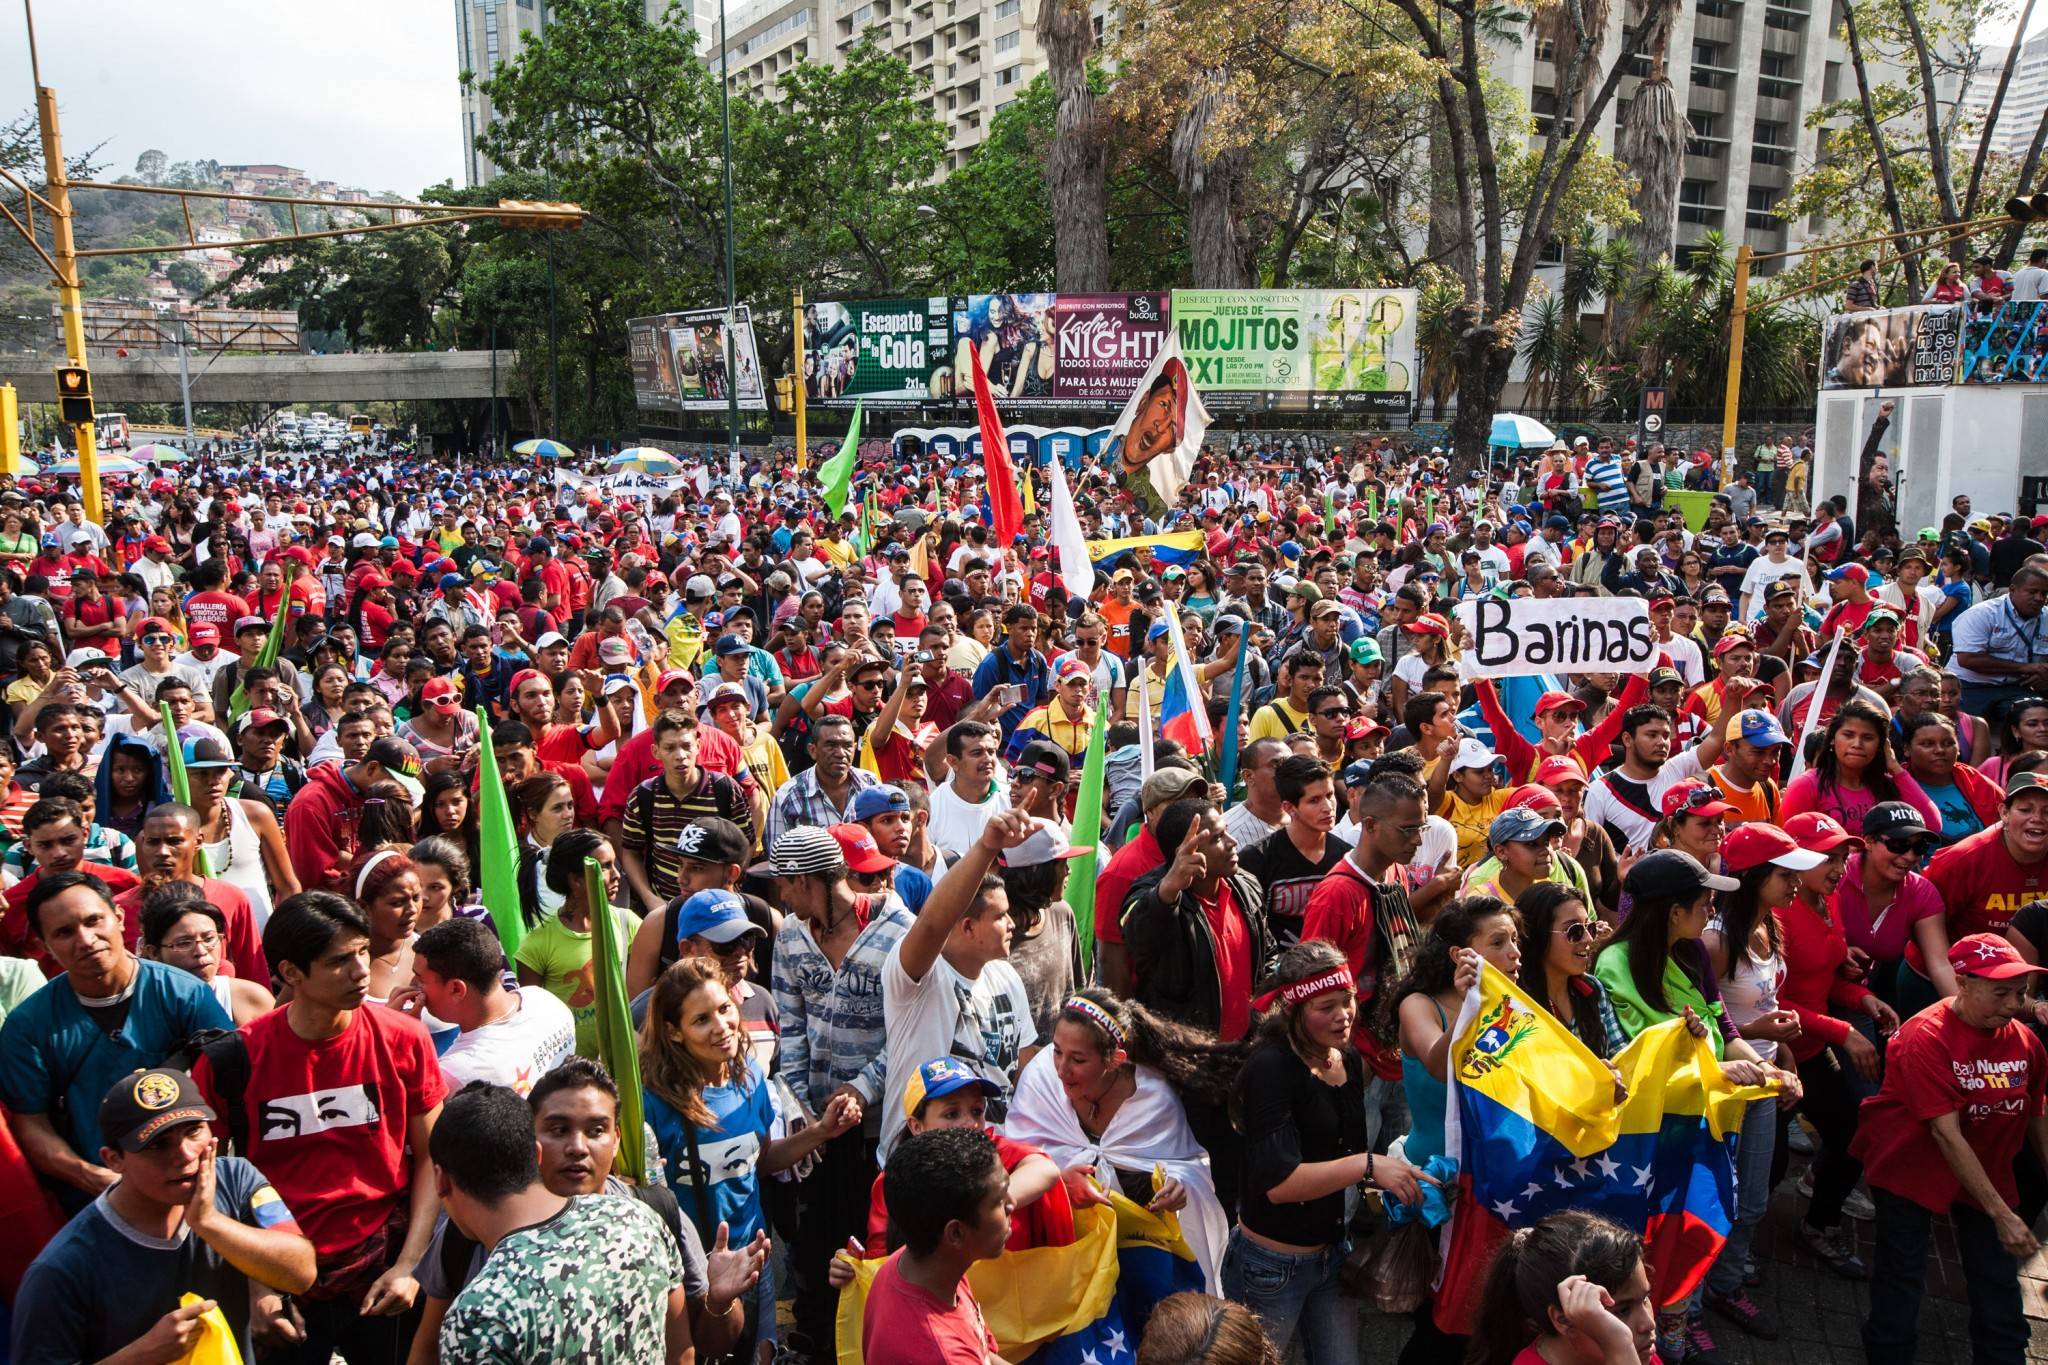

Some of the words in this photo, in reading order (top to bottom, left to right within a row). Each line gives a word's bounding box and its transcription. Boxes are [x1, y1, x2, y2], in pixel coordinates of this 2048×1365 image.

[1250, 296, 1300, 304] NOSOTROS
[1213, 306, 1248, 316] JUEVES
[1251, 306, 1264, 315] DE
[862, 311, 922, 336] Escapate
[1059, 312, 1122, 336] Ladie's
[1918, 312, 1950, 335] Aquí
[1178, 318, 1299, 351] MOJITOS
[1935, 333, 1956, 348] se
[862, 335, 872, 348] de
[872, 344, 880, 358] la
[880, 334, 926, 369] Cola
[1060, 359, 1091, 368] TODOS
[1092, 360, 1110, 368] LOS
[906, 377, 919, 389] 2x1
[1060, 378, 1086, 386] PARA
[1090, 378, 1107, 386] LAS
[1646, 392, 1664, 409] M
[1506, 490, 1518, 502] 57
[1476, 600, 1654, 666] Barinas
[1296, 970, 1348, 998] CHAVISTA
[1976, 1059, 2028, 1074] Nuevo
